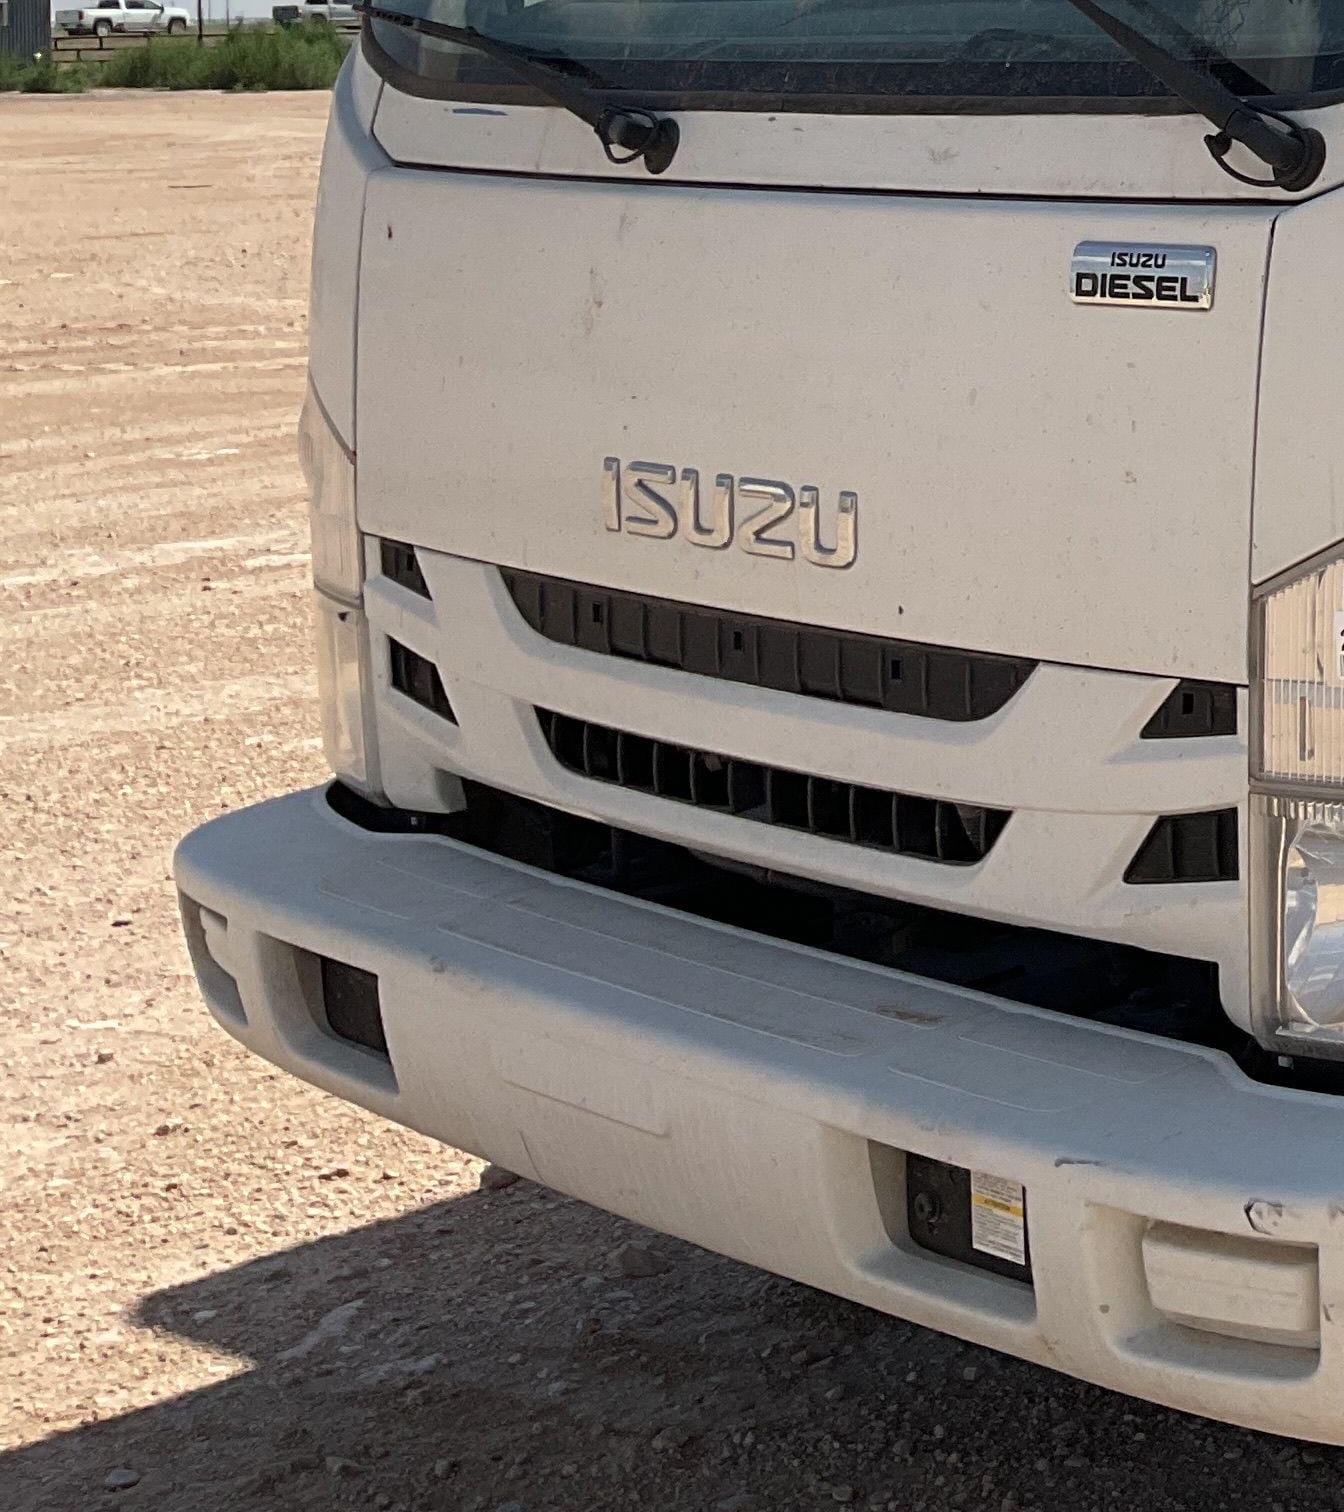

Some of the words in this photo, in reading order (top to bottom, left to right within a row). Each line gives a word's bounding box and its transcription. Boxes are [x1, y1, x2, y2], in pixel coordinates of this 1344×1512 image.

[1110, 251, 1167, 269] ISUZU
[1075, 272, 1200, 303] DIESEL
[603, 456, 858, 571] ISUZU
